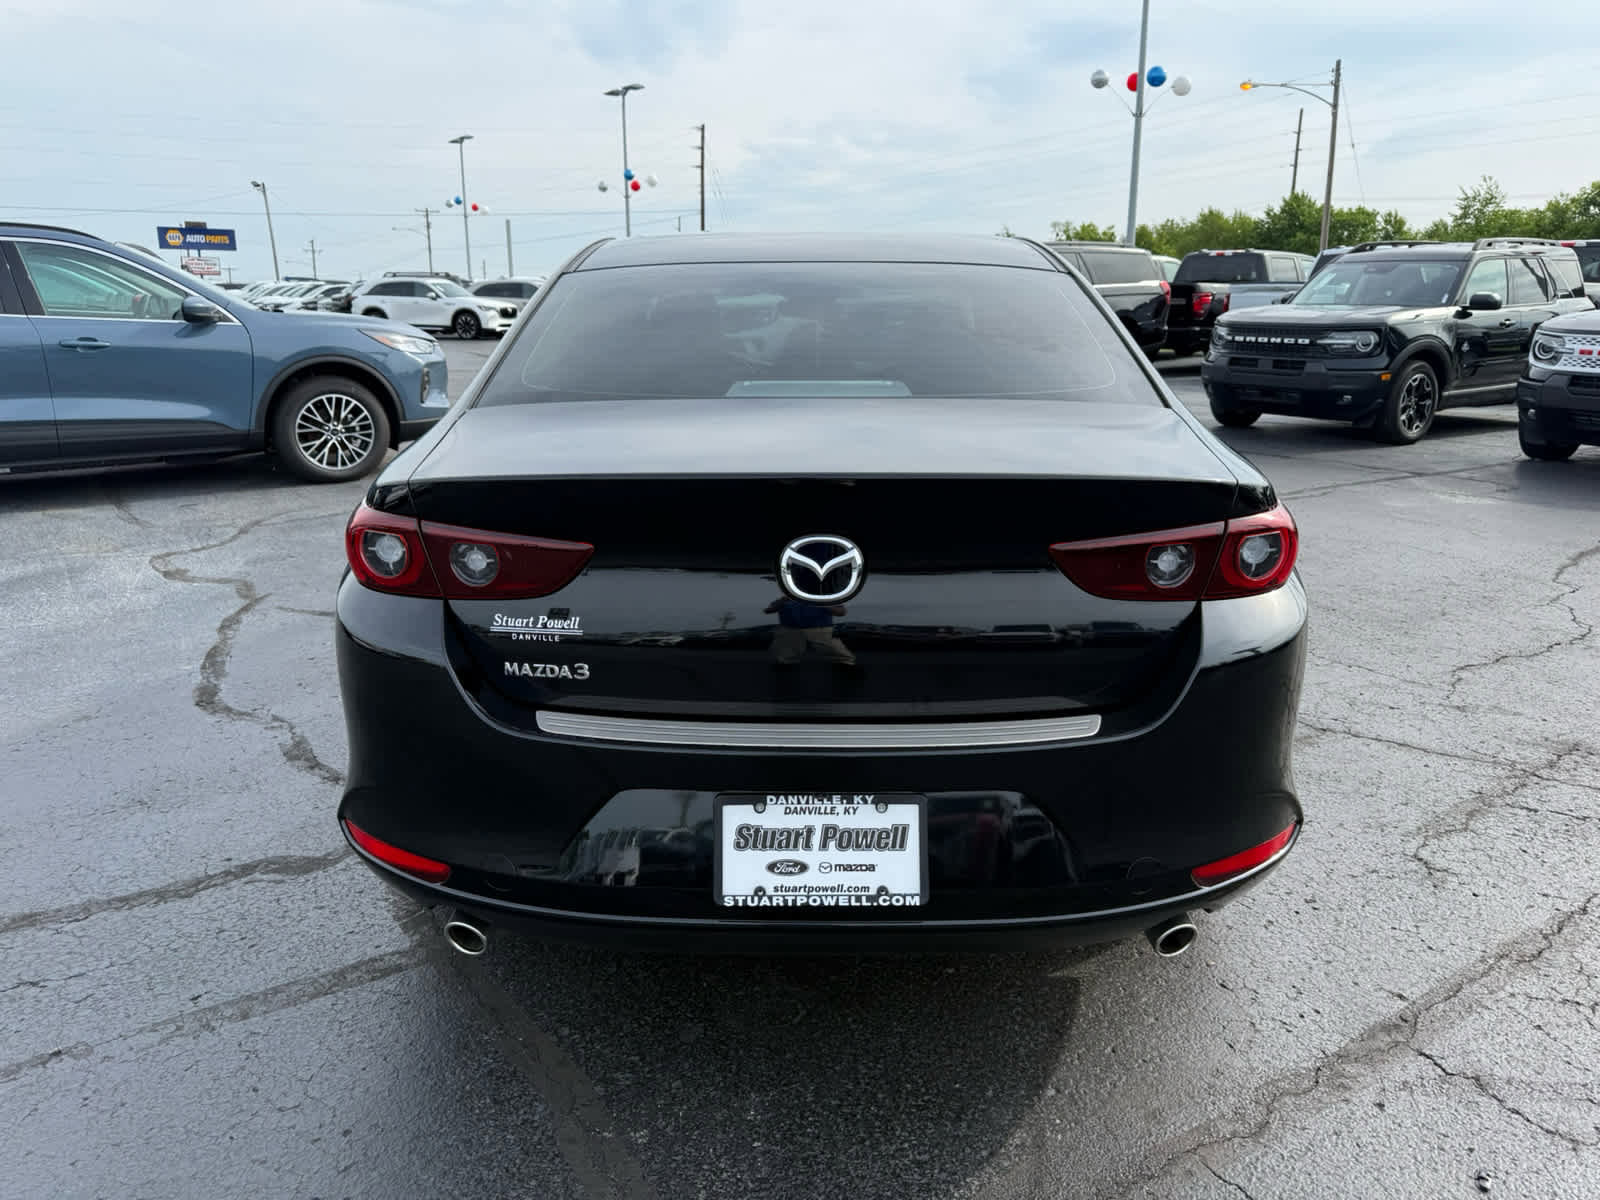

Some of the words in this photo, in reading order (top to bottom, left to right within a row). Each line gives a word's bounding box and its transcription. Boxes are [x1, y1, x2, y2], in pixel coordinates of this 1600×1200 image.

[186, 234, 206, 243] AUTO
[206, 235, 229, 244] PARTS
[1234, 336, 1310, 345] BRONCO
[493, 613, 534, 627] Stuart
[536, 615, 579, 629] Powell
[511, 633, 560, 642] DANVILLE
[853, 795, 874, 804] KY
[784, 806, 840, 816] DANVILLE,
[843, 806, 859, 816] KY
[734, 823, 815, 851] Stuart
[819, 823, 910, 851] Powell
[773, 862, 801, 874] Ford
[772, 884, 871, 895] stuartpowell.com
[723, 895, 920, 907] STUARTPOWELL.COM
